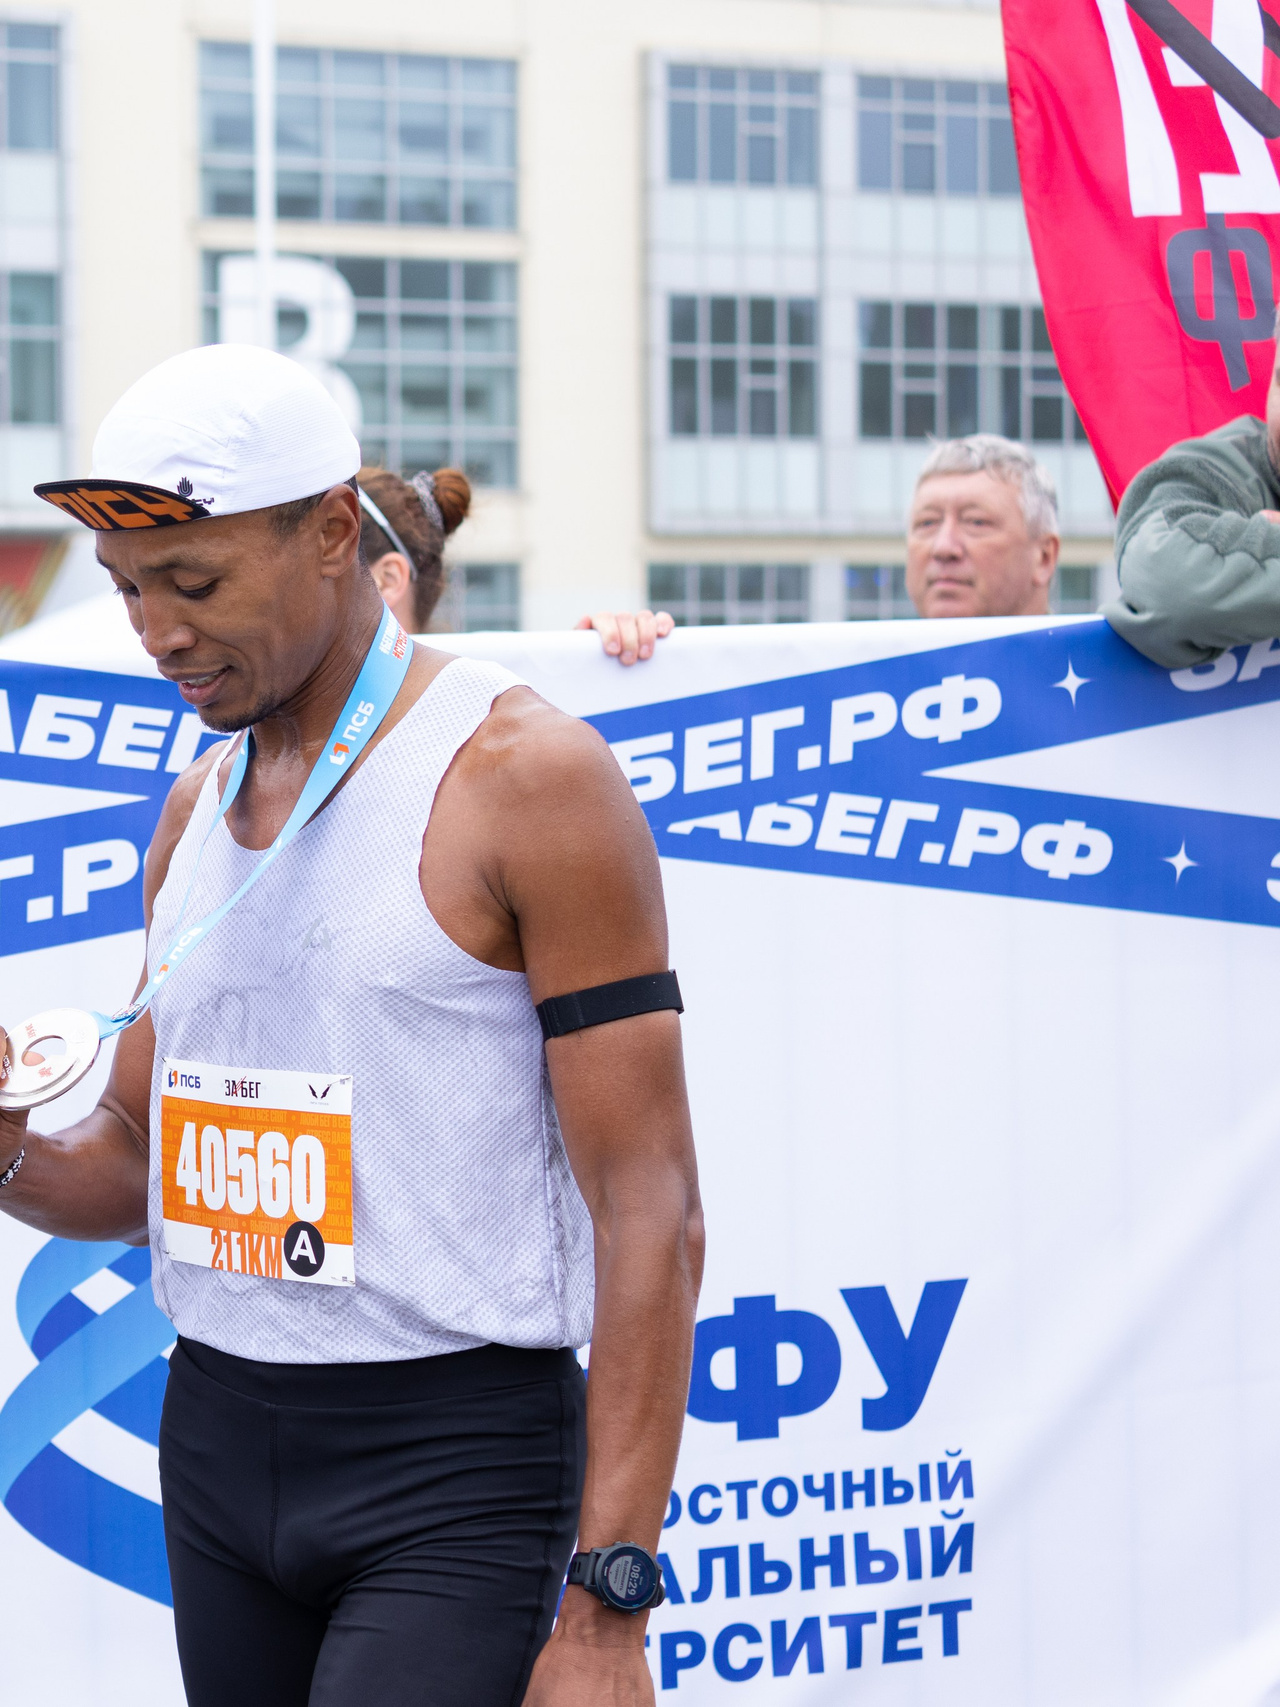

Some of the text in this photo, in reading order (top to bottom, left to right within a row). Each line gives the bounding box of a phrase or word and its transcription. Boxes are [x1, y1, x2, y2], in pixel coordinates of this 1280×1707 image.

[342, 700, 375, 741] ПСБ
[180, 1074, 201, 1089] ПСБ
[176, 1121, 326, 1222] 40560
[644, 1598, 973, 1690] РСИТЕТ
